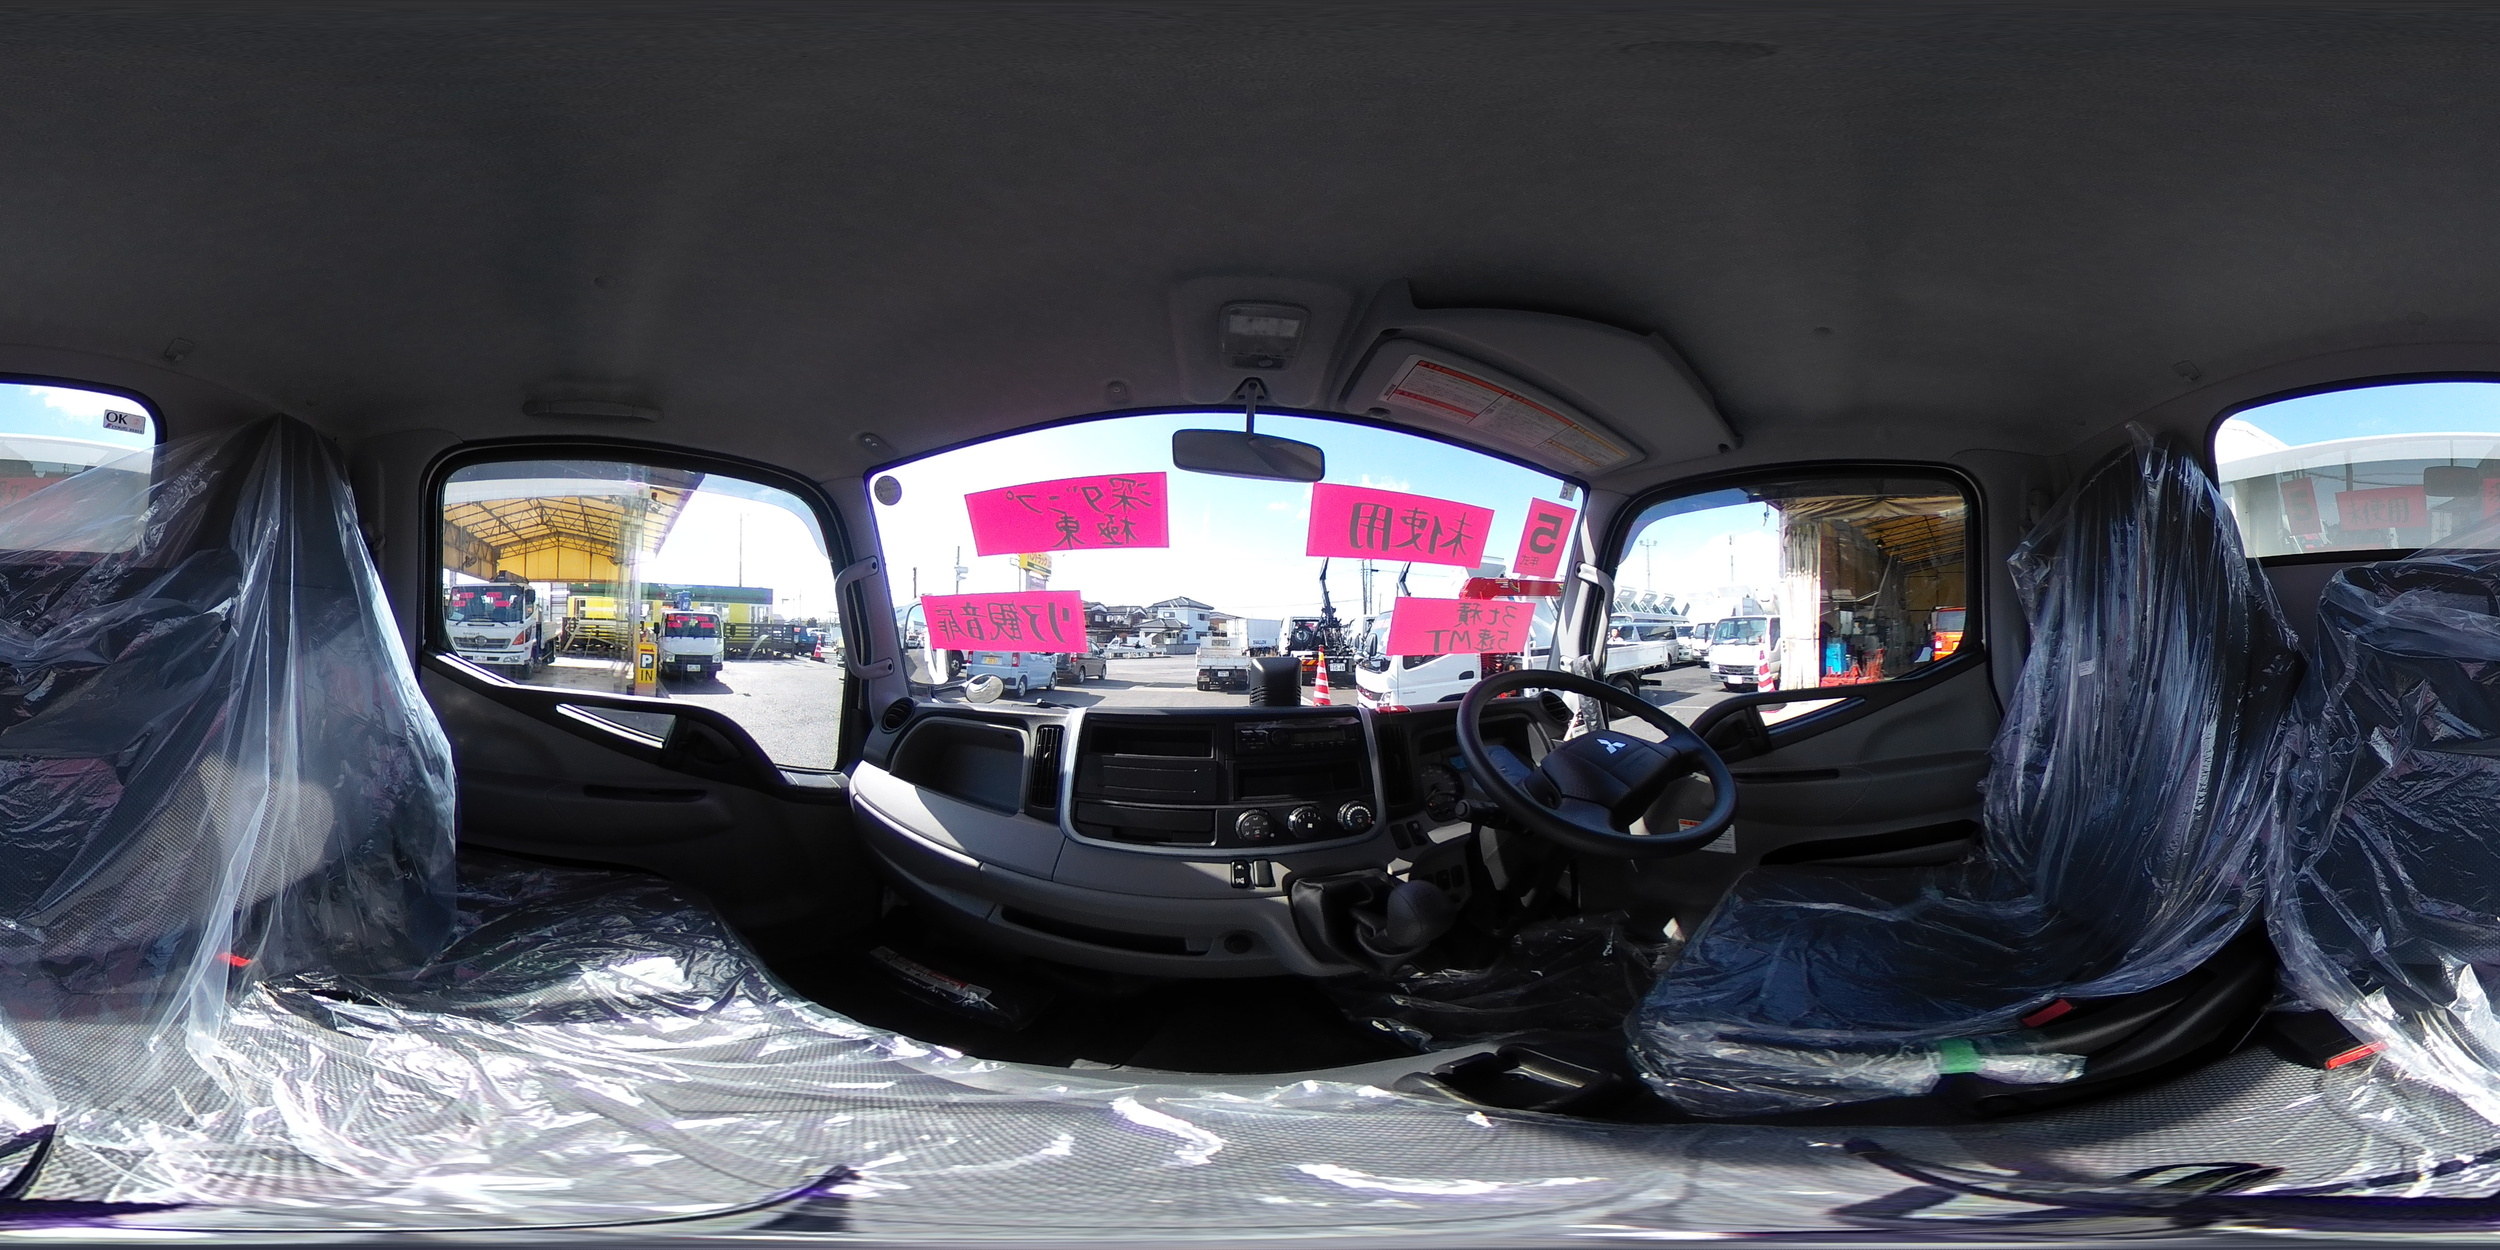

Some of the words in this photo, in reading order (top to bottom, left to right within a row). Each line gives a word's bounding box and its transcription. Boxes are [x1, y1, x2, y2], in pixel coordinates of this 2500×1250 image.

[106, 411, 128, 425] OK
[642, 654, 653, 667] P
[641, 669, 653, 682] IN
